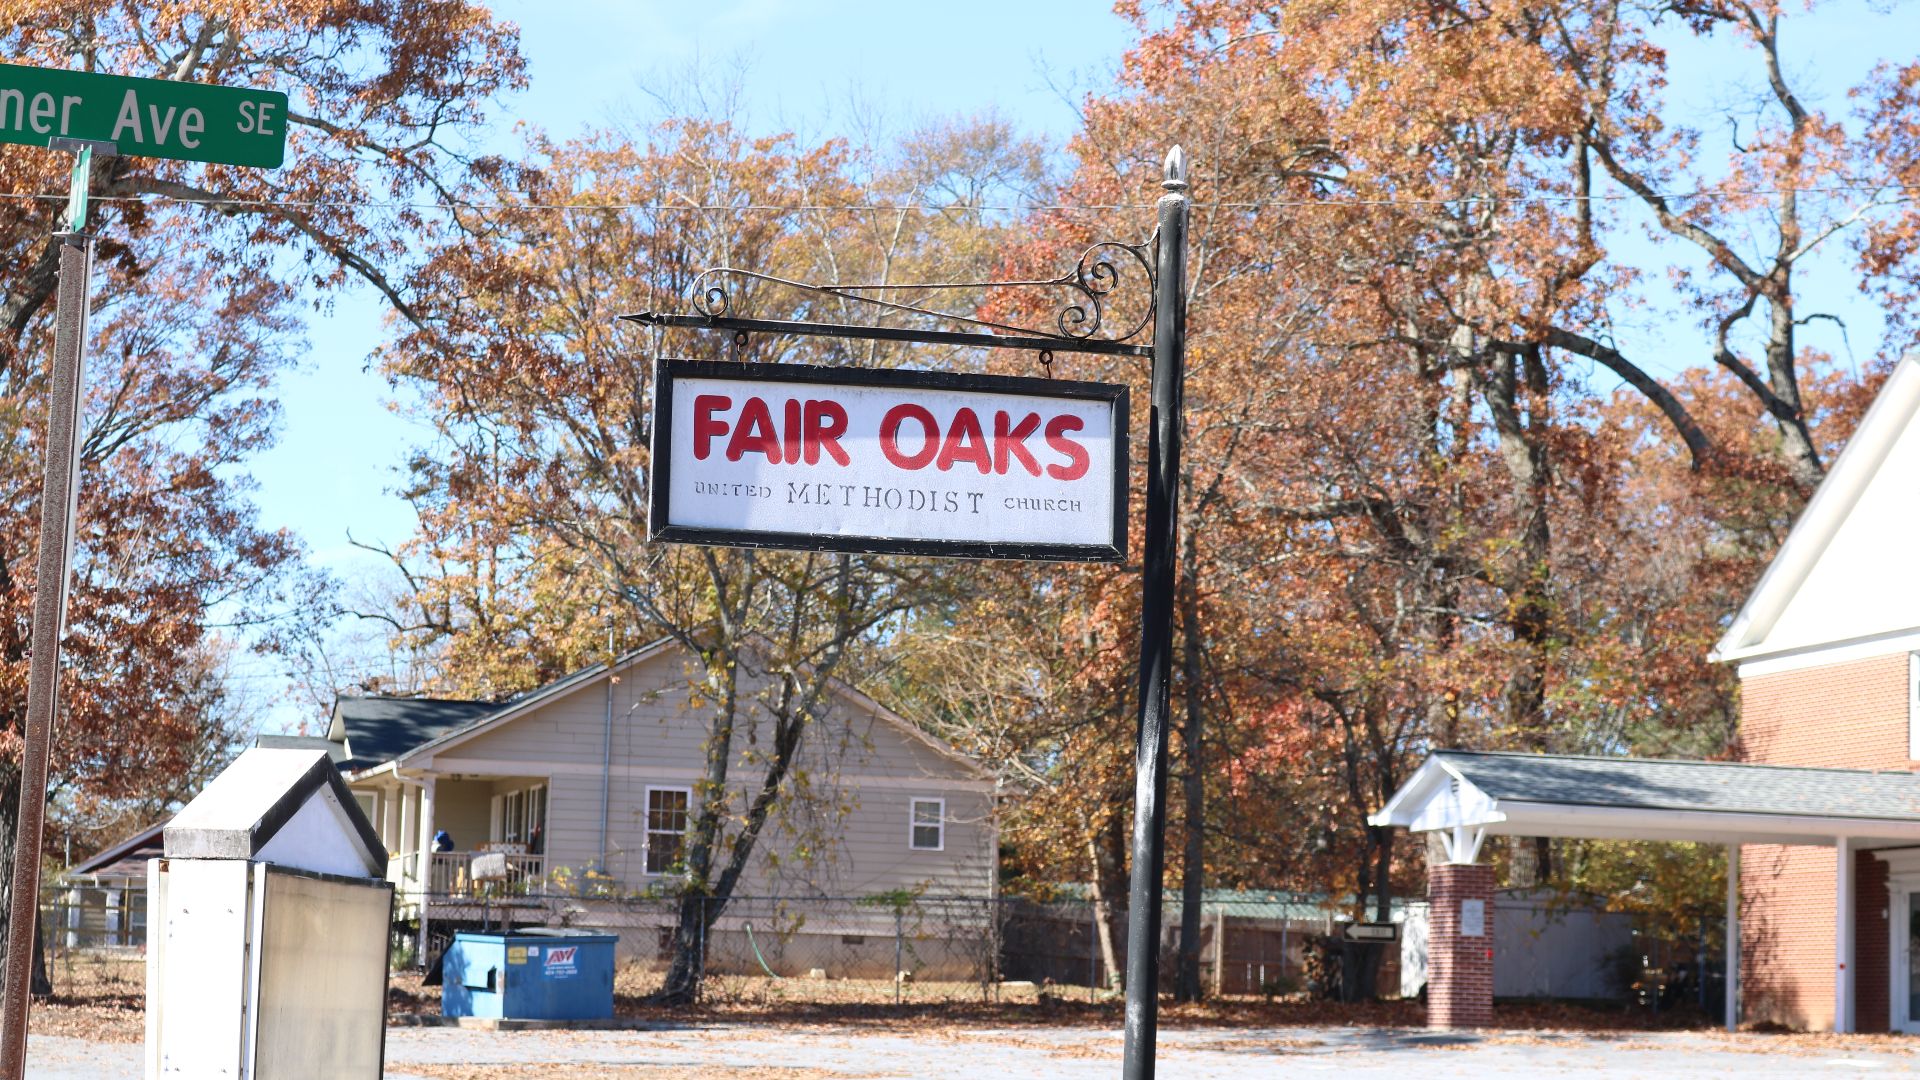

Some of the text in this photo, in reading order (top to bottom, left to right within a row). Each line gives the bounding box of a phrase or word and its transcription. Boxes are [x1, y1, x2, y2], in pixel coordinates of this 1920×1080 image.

[111, 89, 205, 149] Ave
[236, 100, 276, 136] SE
[693, 394, 1091, 481] FAIR OAKS
[694, 481, 1082, 514] UNITED METHODIST CHURCH
